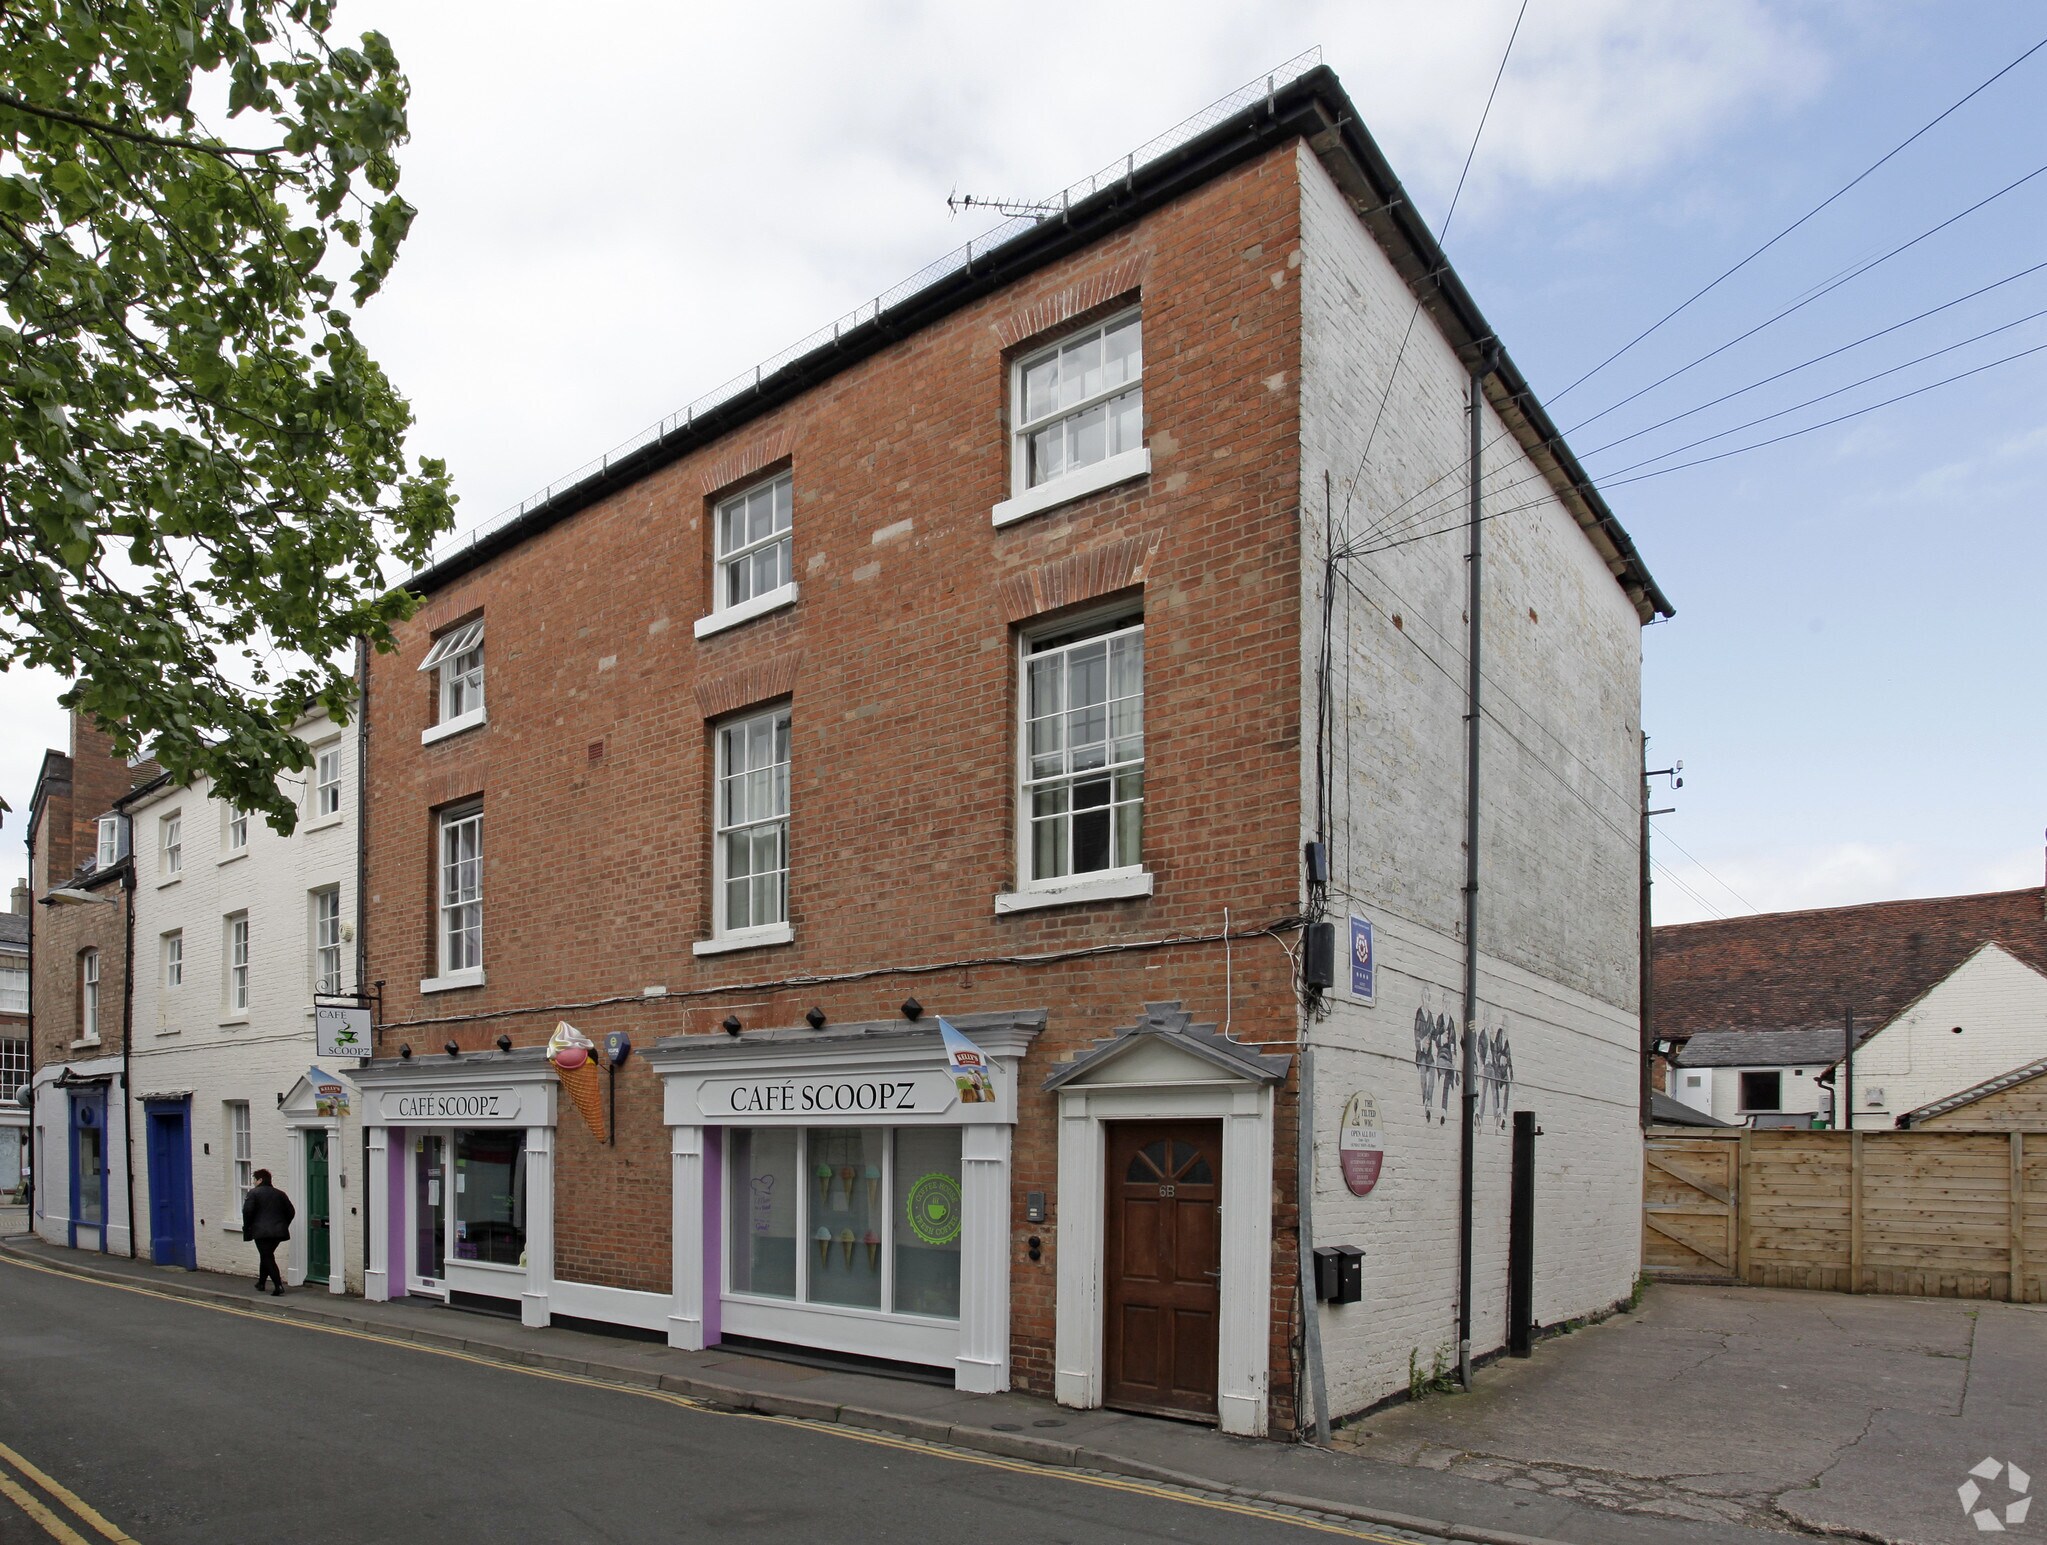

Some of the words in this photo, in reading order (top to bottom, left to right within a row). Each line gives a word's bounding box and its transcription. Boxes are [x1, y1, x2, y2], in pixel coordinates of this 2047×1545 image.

[319, 1010, 347, 1020] CAFÉ
[328, 1046, 370, 1056] SCOOPZ
[399, 1092, 435, 1116] CAFÉ
[438, 1096, 499, 1116] SCOOPZ
[730, 1080, 795, 1111] CAFÉ
[801, 1082, 916, 1110] SCOOPZ
[916, 1182, 938, 1202] COFFEE
[939, 1183, 959, 1203] HOUSE
[1159, 1185, 1175, 1198] 6B
[935, 1215, 959, 1236] COFFEE
